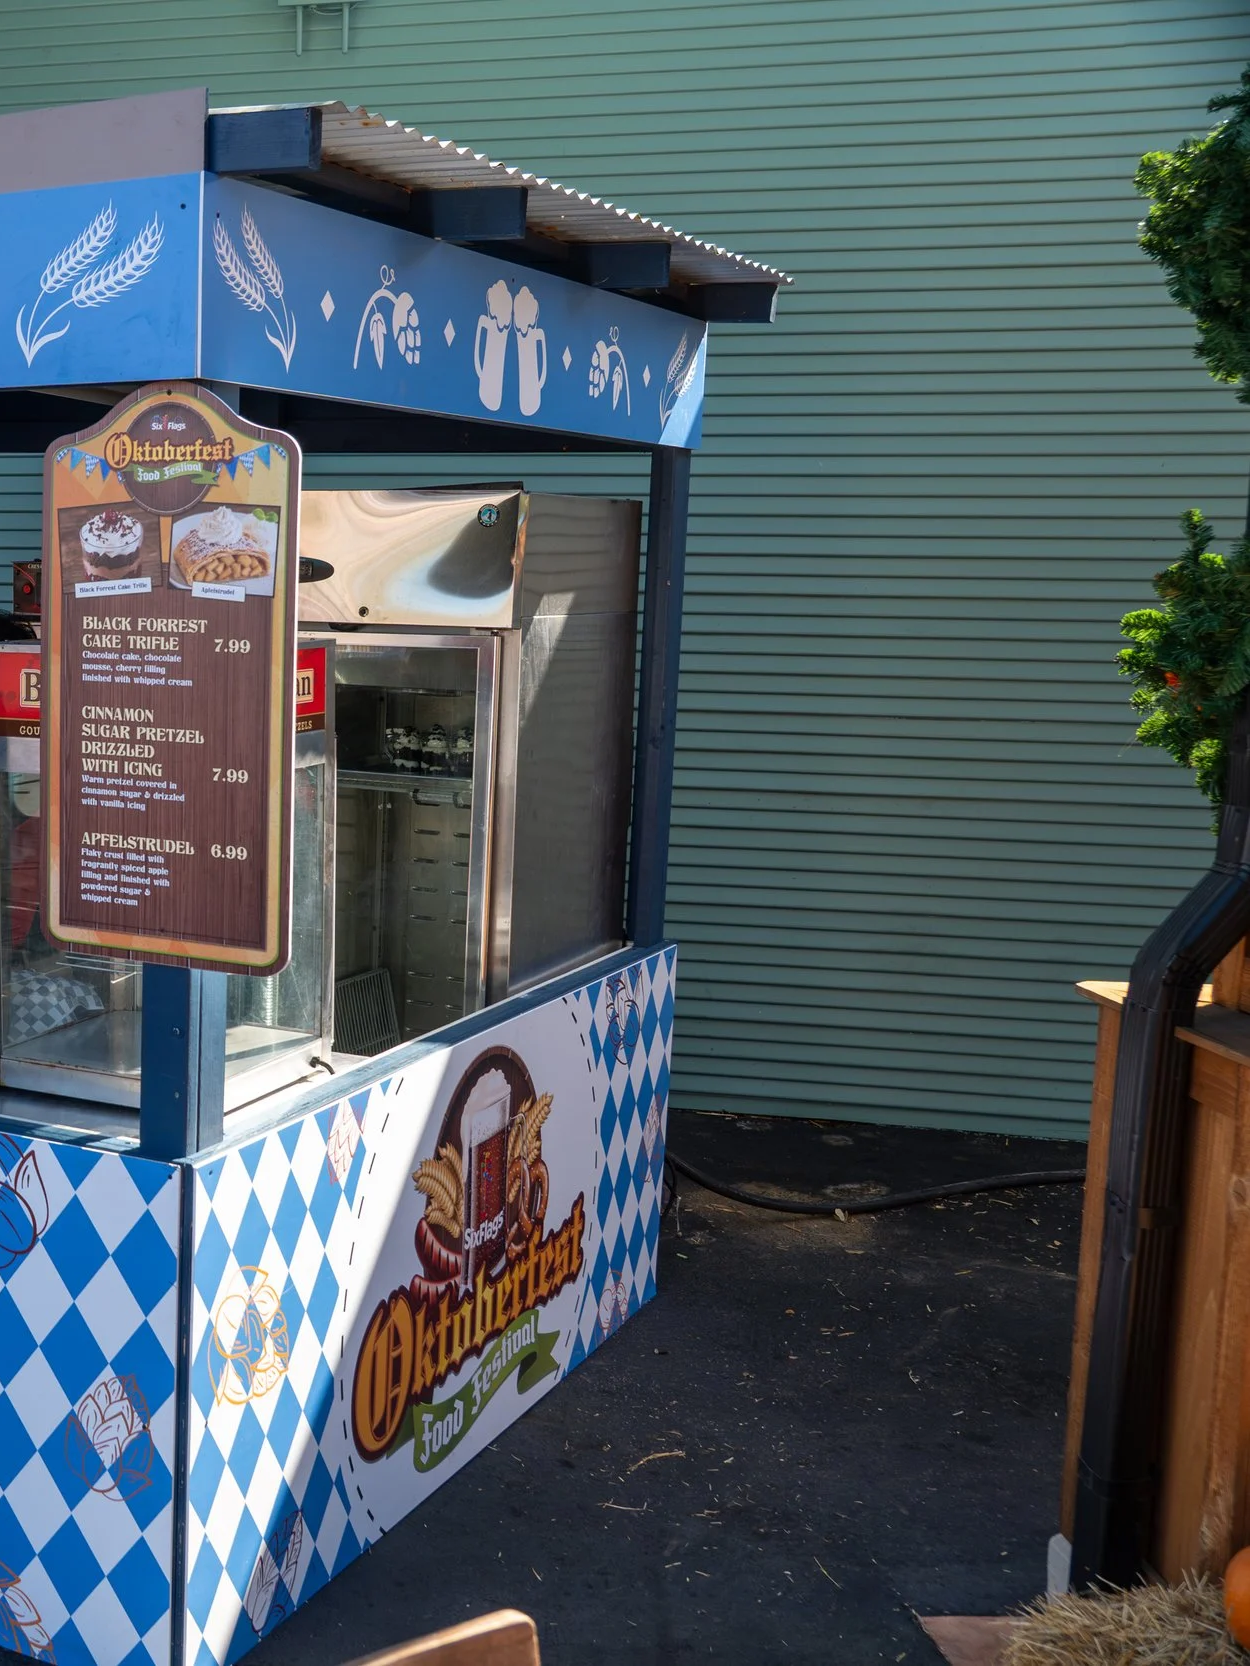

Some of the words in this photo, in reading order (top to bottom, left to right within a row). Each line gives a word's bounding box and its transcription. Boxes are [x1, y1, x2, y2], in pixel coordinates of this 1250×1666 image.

[151, 422, 163, 430] Six
[167, 422, 186, 431] Flags
[104, 432, 234, 470] Oktoberfest
[137, 467, 160, 482] Food
[163, 462, 202, 479] Festival
[83, 616, 132, 631] BLACK
[137, 618, 208, 634] FORREST
[82, 634, 122, 649] CAKE
[127, 635, 179, 651] TRIFLE
[214, 639, 251, 654] 7.99
[82, 650, 119, 660] Chocolate
[121, 651, 142, 661] cake,
[144, 652, 182, 662] chocolate
[82, 662, 113, 672] mousse,
[115, 663, 141, 674] cherry
[144, 665, 166, 675] filling
[82, 673, 112, 683] finished
[114, 675, 131, 684] with
[133, 676, 165, 686] whipped
[168, 679, 192, 687] cream
[82, 705, 154, 723] CINNAMON
[19, 725, 41, 736] GOU
[296, 720, 313, 731] ZELS
[81, 723, 130, 739] SUGAR
[136, 726, 205, 744] PRETZEL
[81, 741, 155, 759] DRIZZLED
[82, 758, 119, 774] WITH
[124, 760, 163, 777] ICING
[212, 767, 249, 784] 7.99
[81, 775, 104, 784] Warm
[106, 776, 134, 787] pretzel
[135, 779, 167, 789] covered
[169, 781, 177, 790] in
[81, 786, 117, 796] cinnamon
[119, 790, 142, 799] sugar
[152, 792, 185, 802] drizzled
[81, 797, 98, 806] with
[100, 799, 125, 808] vanilla
[127, 801, 146, 811] icing
[81, 831, 195, 855] APFELSTRUDEL
[210, 843, 248, 861] 6.99
[81, 848, 102, 858] Flaky
[104, 850, 124, 860] crust
[126, 852, 145, 862] filled
[148, 854, 165, 864] with
[81, 859, 119, 872] fragrantly
[121, 863, 146, 873] spiced
[148, 866, 169, 876] apple
[81, 870, 102, 881] filling
[104, 873, 118, 882] and
[120, 874, 150, 886] finished
[153, 877, 170, 887] with
[81, 882, 118, 893] powdered
[119, 886, 142, 896] sugar
[81, 893, 112, 904] whipped
[114, 897, 138, 906] cream
[353, 1200, 584, 1456] Oktoberfest
[420, 1400, 465, 1465] Food
[471, 1314, 536, 1416] Festival
